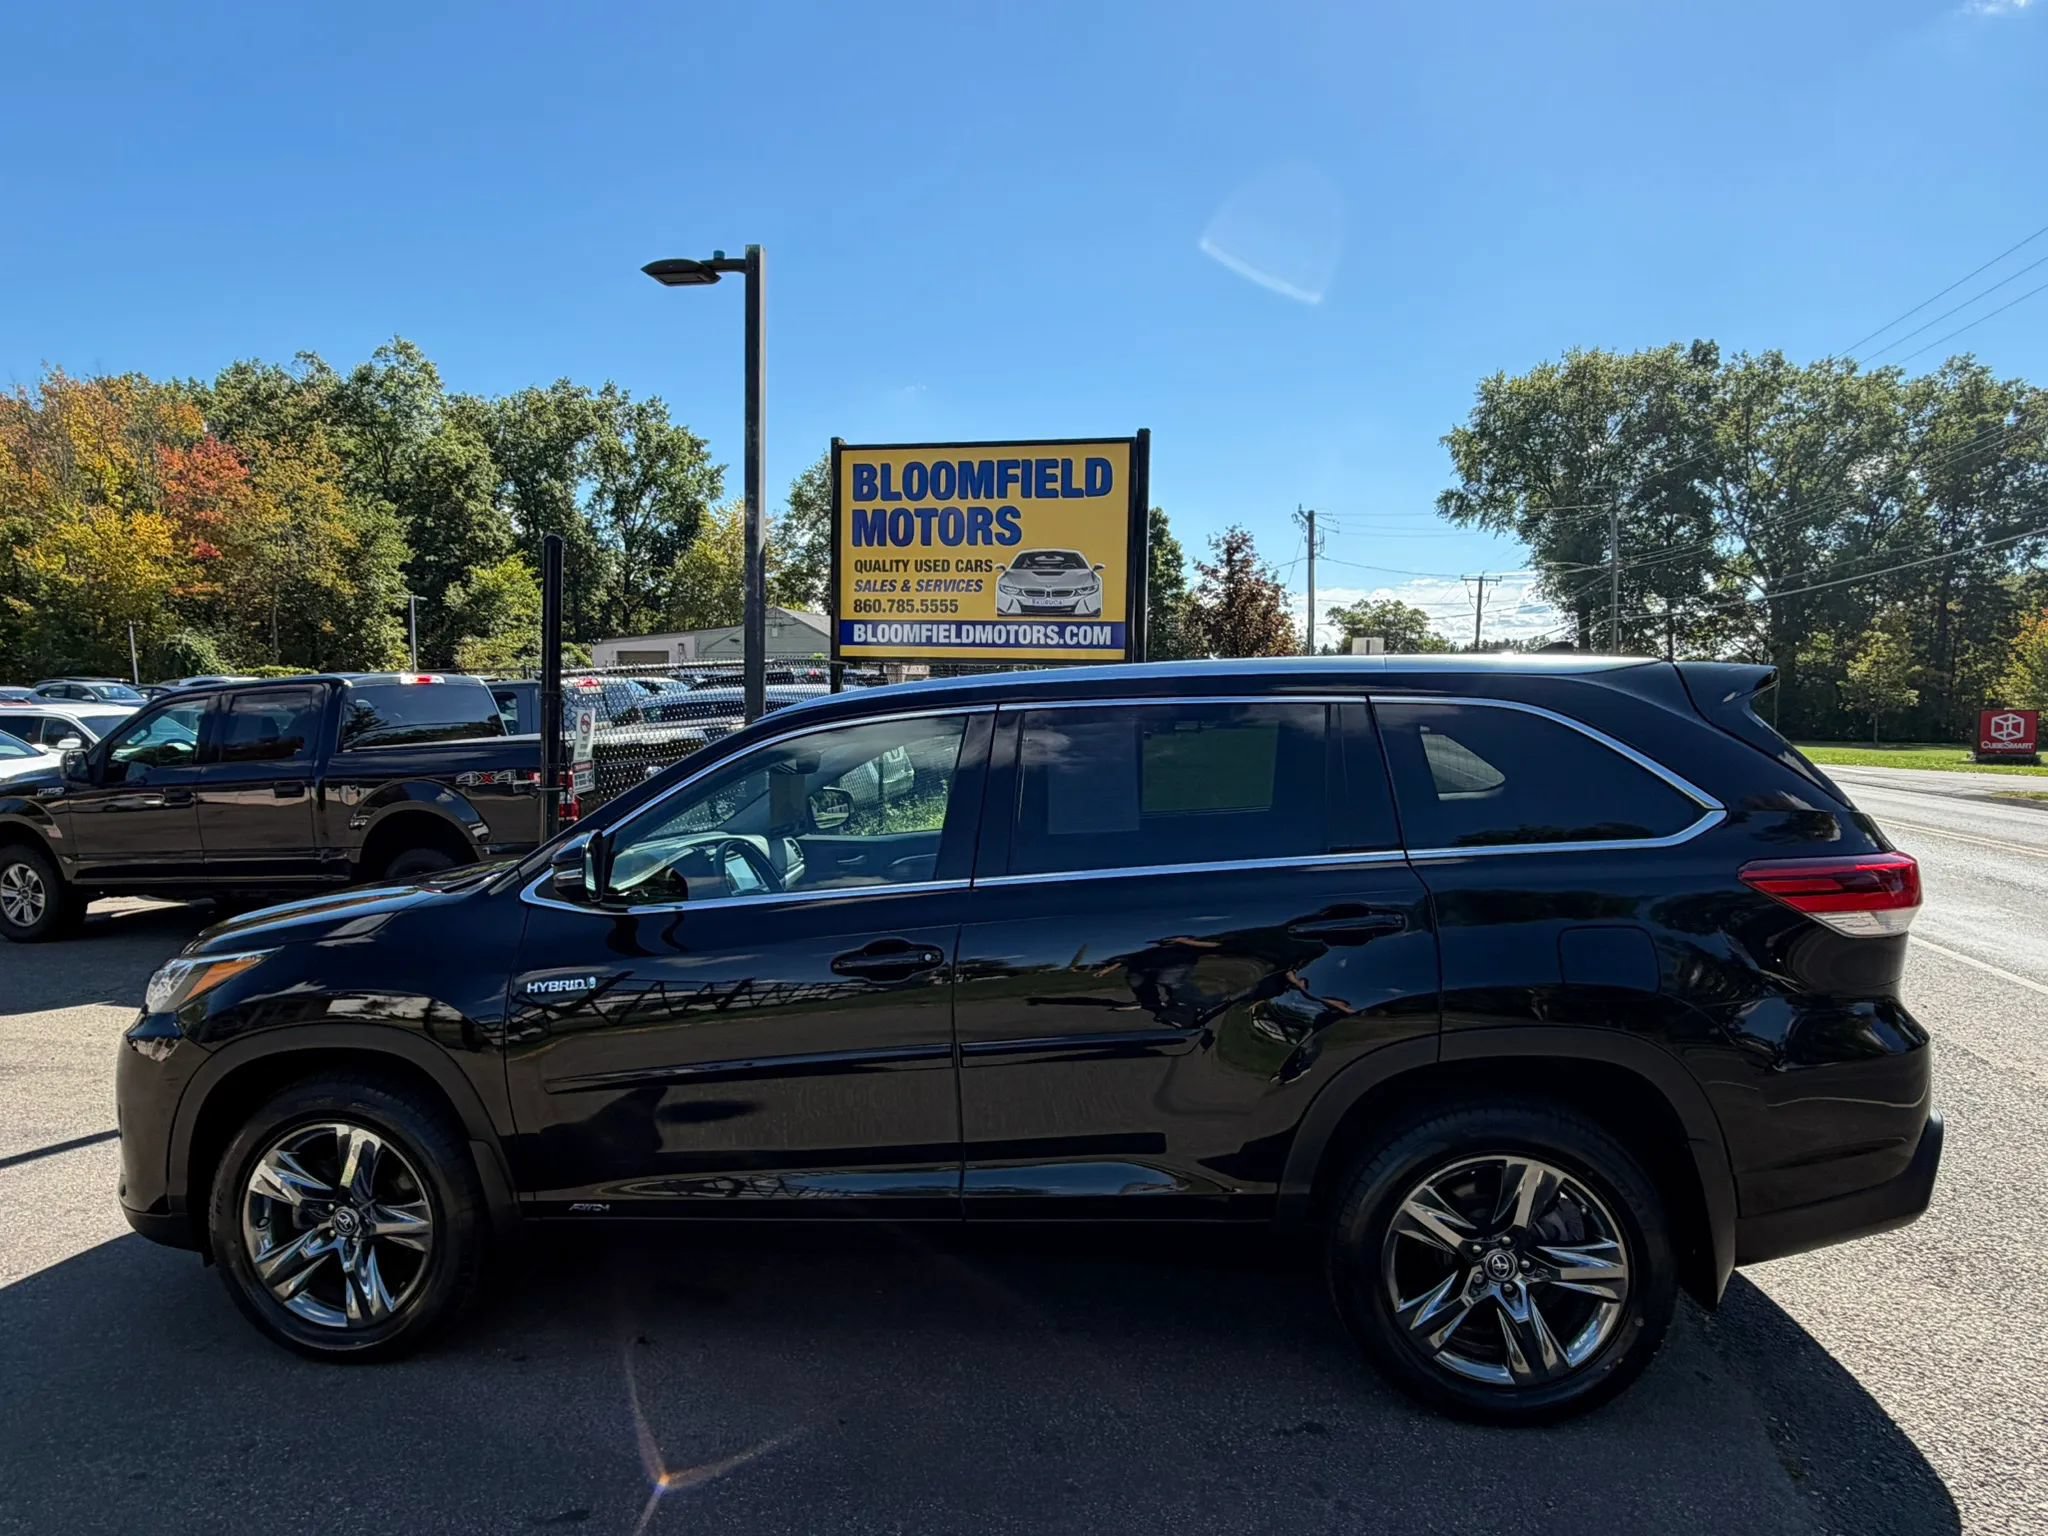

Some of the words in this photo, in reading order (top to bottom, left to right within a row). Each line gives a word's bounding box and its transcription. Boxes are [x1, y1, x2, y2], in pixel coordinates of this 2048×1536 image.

[852, 457, 1113, 501] BLOOMFIELD
[851, 505, 1023, 547] MOTORS
[854, 559, 910, 574] QUALITY
[914, 559, 950, 573] USED
[955, 559, 993, 573] CARS
[854, 579, 897, 593] SALES
[900, 579, 911, 592] &
[915, 579, 983, 593] SERVICES
[853, 599, 959, 614] 860.785.5555
[853, 623, 1112, 645] BLOOMFIELDMOTORS.COM
[526, 979, 586, 993] HYBRID
